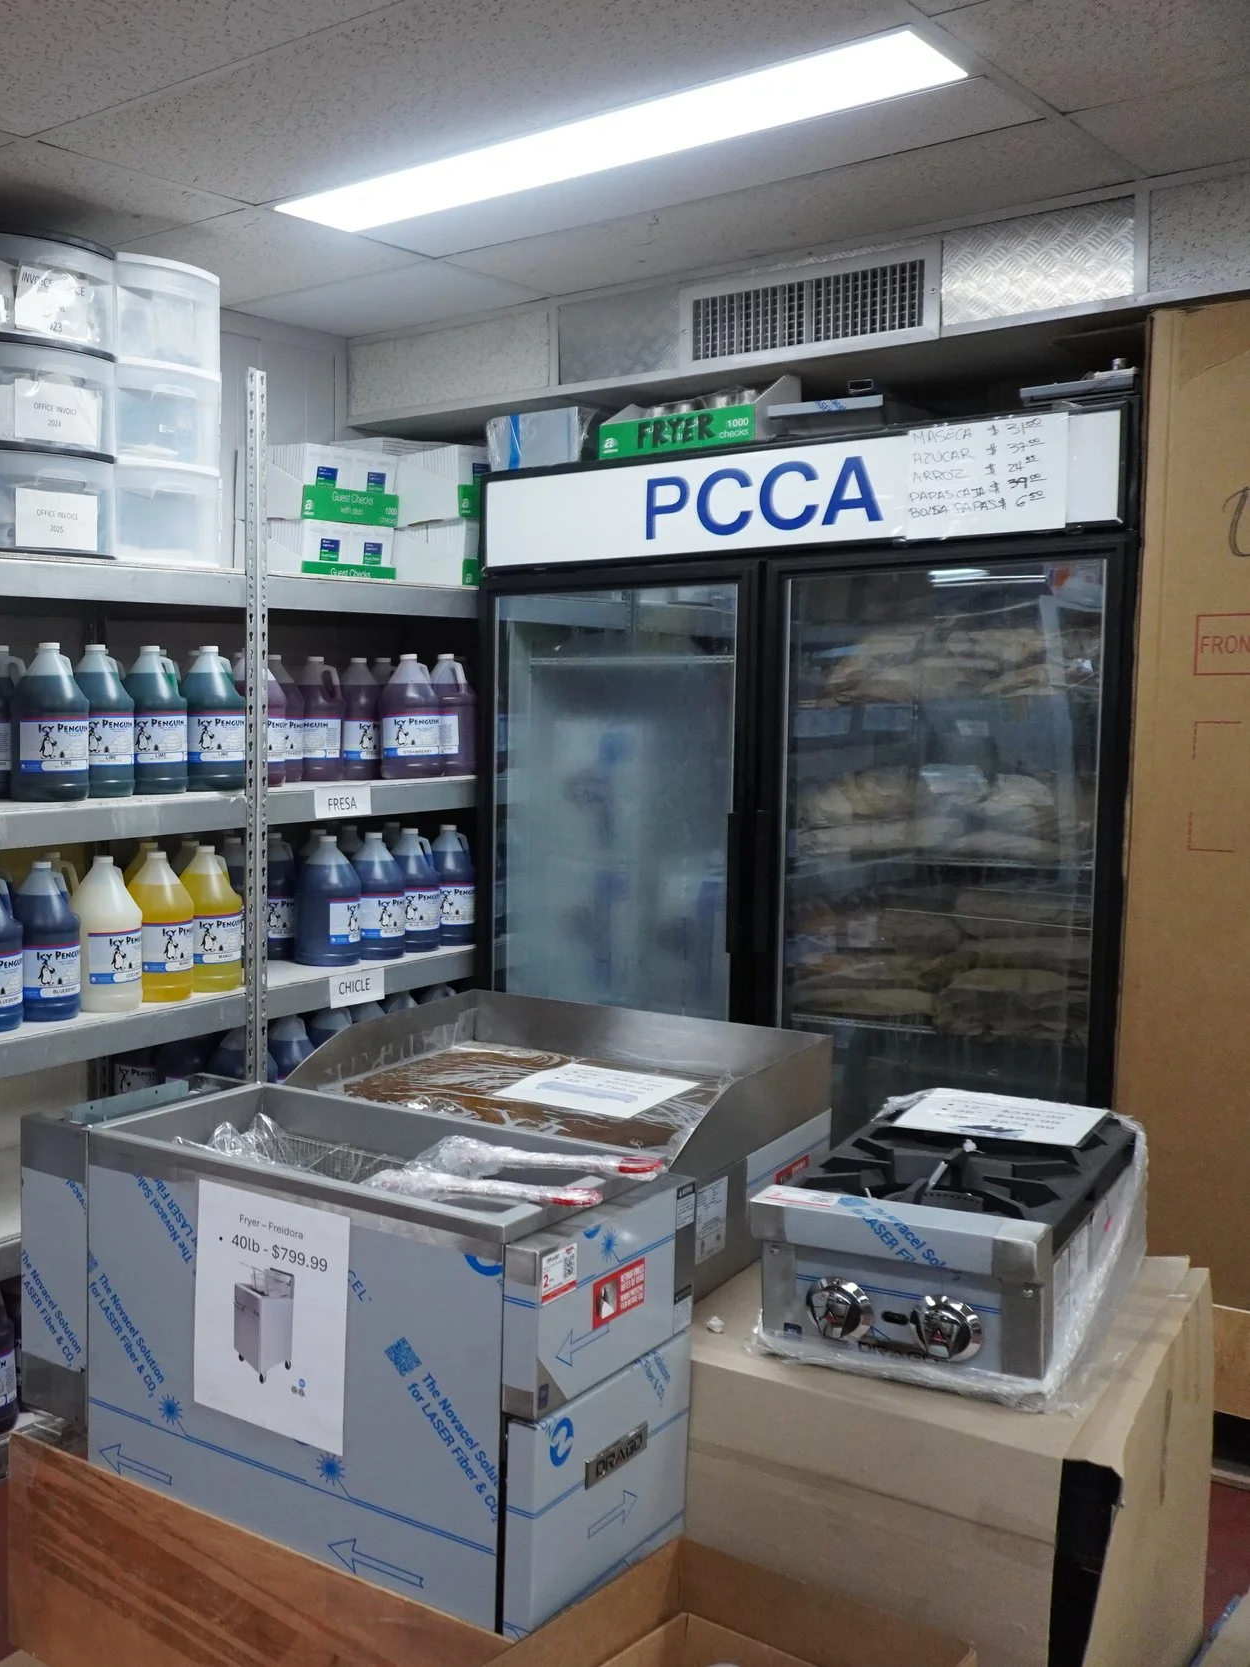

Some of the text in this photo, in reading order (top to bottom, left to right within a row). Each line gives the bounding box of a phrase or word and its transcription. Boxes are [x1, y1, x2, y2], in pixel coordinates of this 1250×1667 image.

[34, 402, 78, 416] OFFICE INVOICE
[727, 417, 750, 428] 1000
[637, 411, 716, 449] FRYER
[719, 427, 750, 439] checks
[912, 428, 972, 444] MASECA
[913, 447, 975, 464] AZUCAR
[912, 469, 968, 482] ARROZ
[332, 491, 374, 505] Guest Checks
[646, 455, 884, 540] PCCA
[36, 508, 56, 518] OFFICE
[385, 507, 398, 515] 1000
[379, 516, 397, 525] checks
[330, 567, 371, 578] Guest Checks
[38, 724, 54, 734] ICY
[151, 718, 184, 727] PENGUIN
[198, 719, 212, 728] ICY
[409, 718, 439, 726] PENGUIN
[328, 797, 357, 811] FRESA
[199, 921, 214, 930] ICY
[162, 928, 177, 938] ICY
[109, 938, 124, 947] ICY
[37, 951, 52, 960] ICY
[339, 979, 370, 995] CHICLE
[166, 1198, 193, 1236] LASER
[150, 1196, 192, 1264] The Novacel
[239, 1213, 304, 1240] Fryer Freidora
[231, 1234, 328, 1272] 40lb $799.99
[31, 1269, 57, 1311] Novacel
[54, 1310, 82, 1354] Solution
[39, 1307, 57, 1335] Fiber
[88, 1281, 103, 1302] for
[98, 1299, 123, 1336] LASER
[119, 1334, 139, 1364] Fiber
[98, 1273, 165, 1384] The Novacel Solution
[421, 1372, 480, 1451] The Novacel
[407, 1382, 424, 1403] for
[421, 1402, 456, 1447] LASER
[450, 1446, 479, 1481] Fiber
[474, 1482, 487, 1496] &
[596, 1433, 643, 1477] DRAGO
